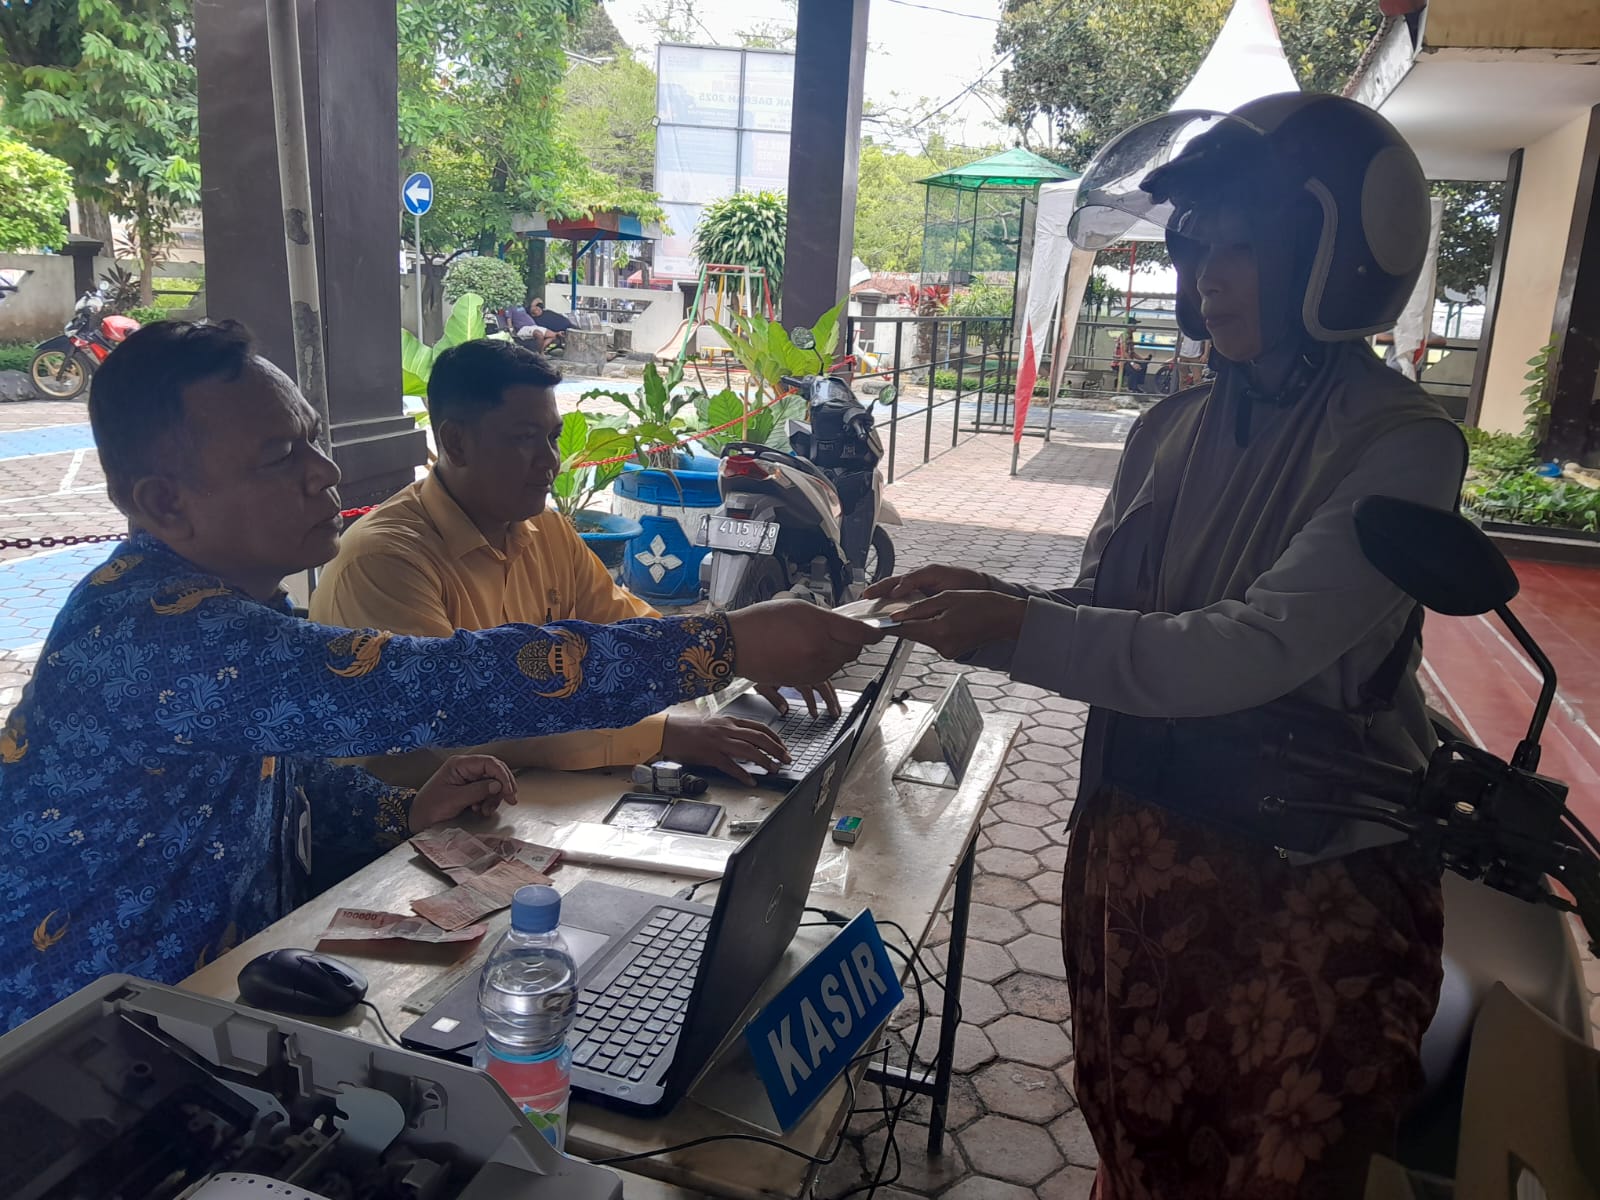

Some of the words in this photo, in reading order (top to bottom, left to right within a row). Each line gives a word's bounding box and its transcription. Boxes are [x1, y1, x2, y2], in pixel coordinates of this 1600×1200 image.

[719, 520, 750, 535] 4115
[341, 910, 378, 921] 100000
[766, 941, 888, 1097] KASIR
